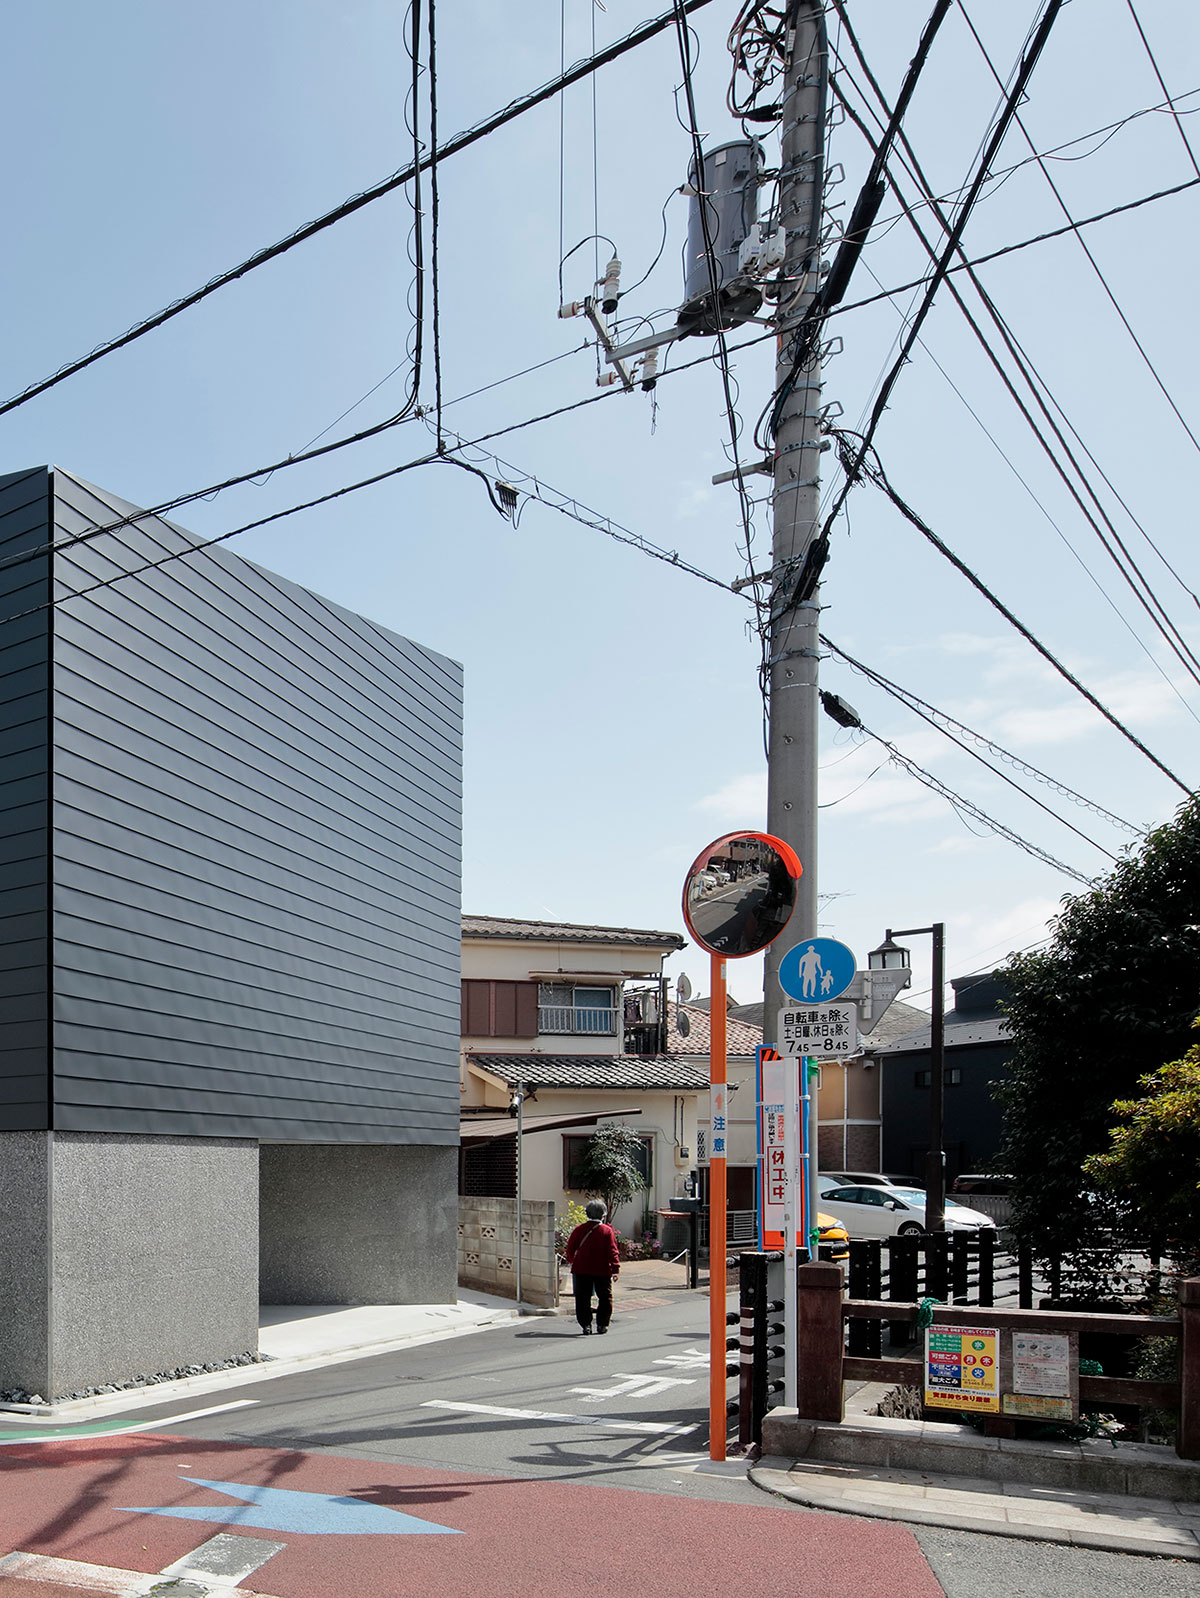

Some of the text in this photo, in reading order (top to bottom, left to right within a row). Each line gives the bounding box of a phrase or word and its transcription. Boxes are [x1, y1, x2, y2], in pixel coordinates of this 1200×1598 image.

[784, 1009, 849, 1025] 自転車を除く
[713, 1116, 726, 1152] 注意
[931, 1352, 958, 1360] 可燃ごみ
[974, 1369, 983, 1377] 火
